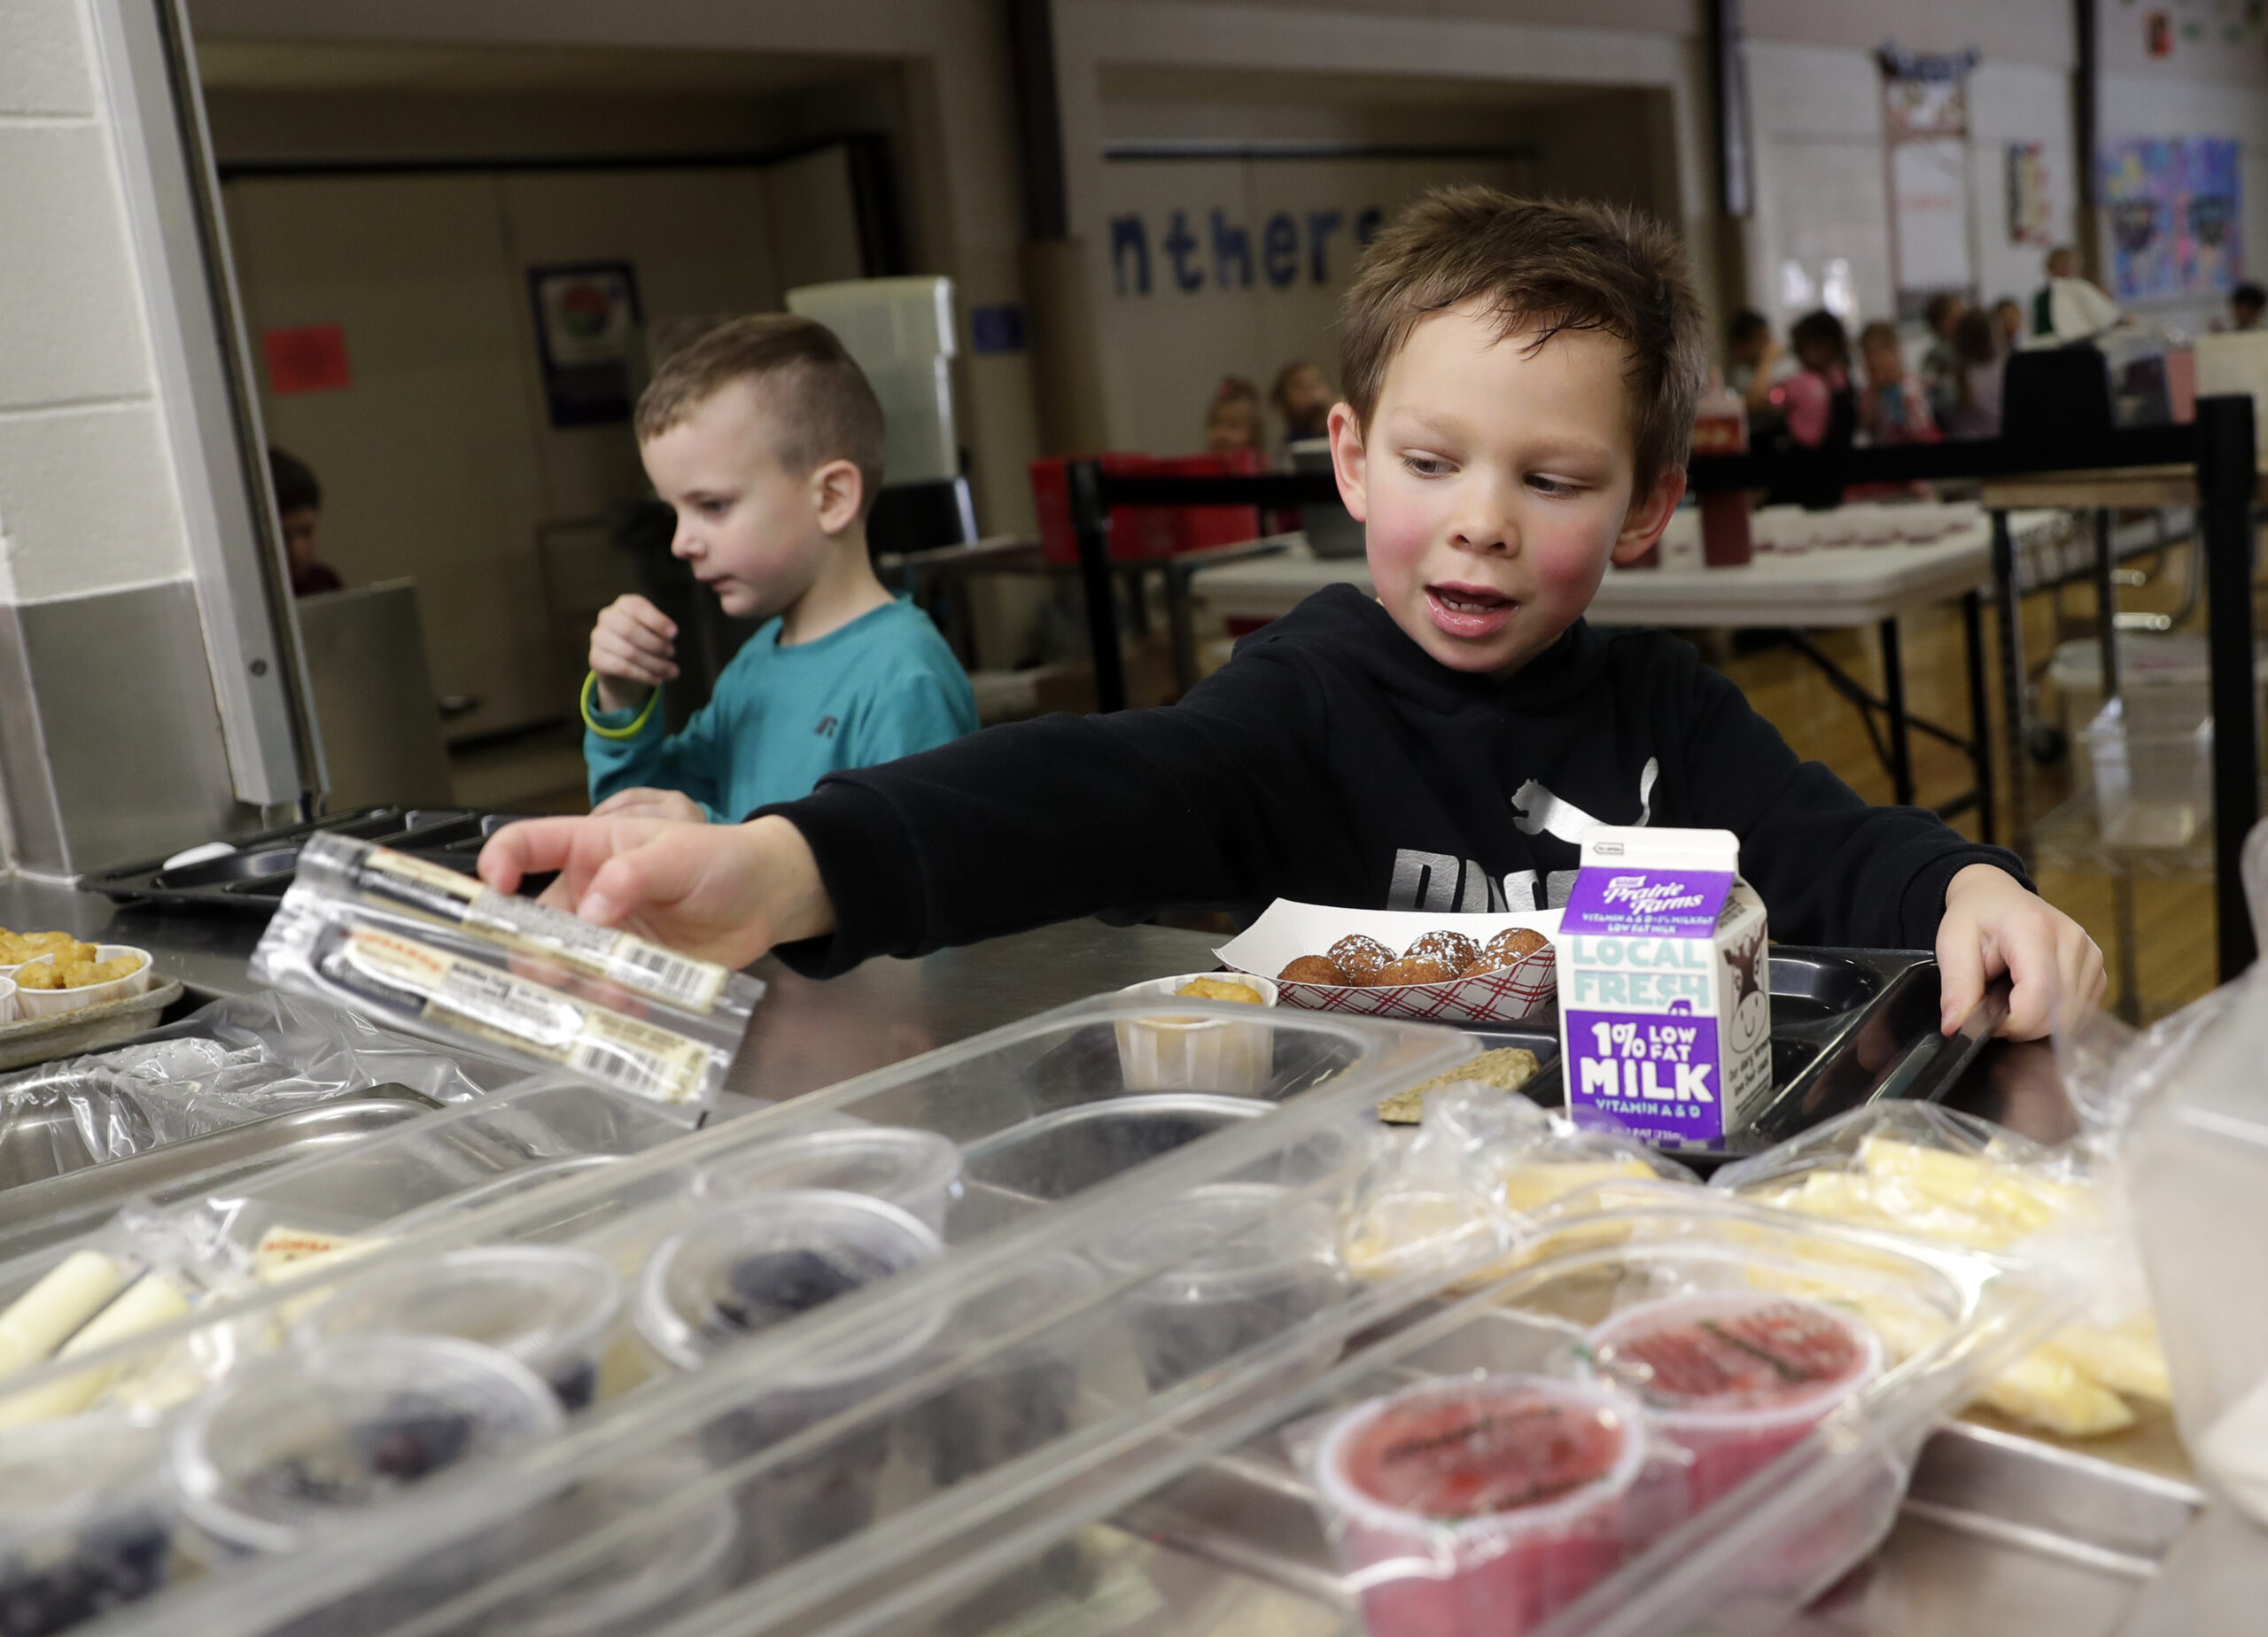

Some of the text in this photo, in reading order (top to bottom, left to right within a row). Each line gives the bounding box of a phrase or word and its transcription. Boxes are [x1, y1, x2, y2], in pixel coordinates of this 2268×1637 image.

[1603, 881, 1685, 904] Prairie
[1629, 893, 1705, 916] Farms
[1582, 913, 1624, 923] VITAMIN
[1573, 937, 1707, 969] LOCAL
[1574, 970, 1710, 1008] FRESH
[1591, 1022, 1697, 1059] 1% LOW
[1650, 1044, 1692, 1062] FAT
[1580, 1057, 1714, 1103] MILK
[1596, 1098, 1658, 1115] VITAMIN
[1661, 1104, 1673, 1118] A
[1689, 1105, 1701, 1119] D
